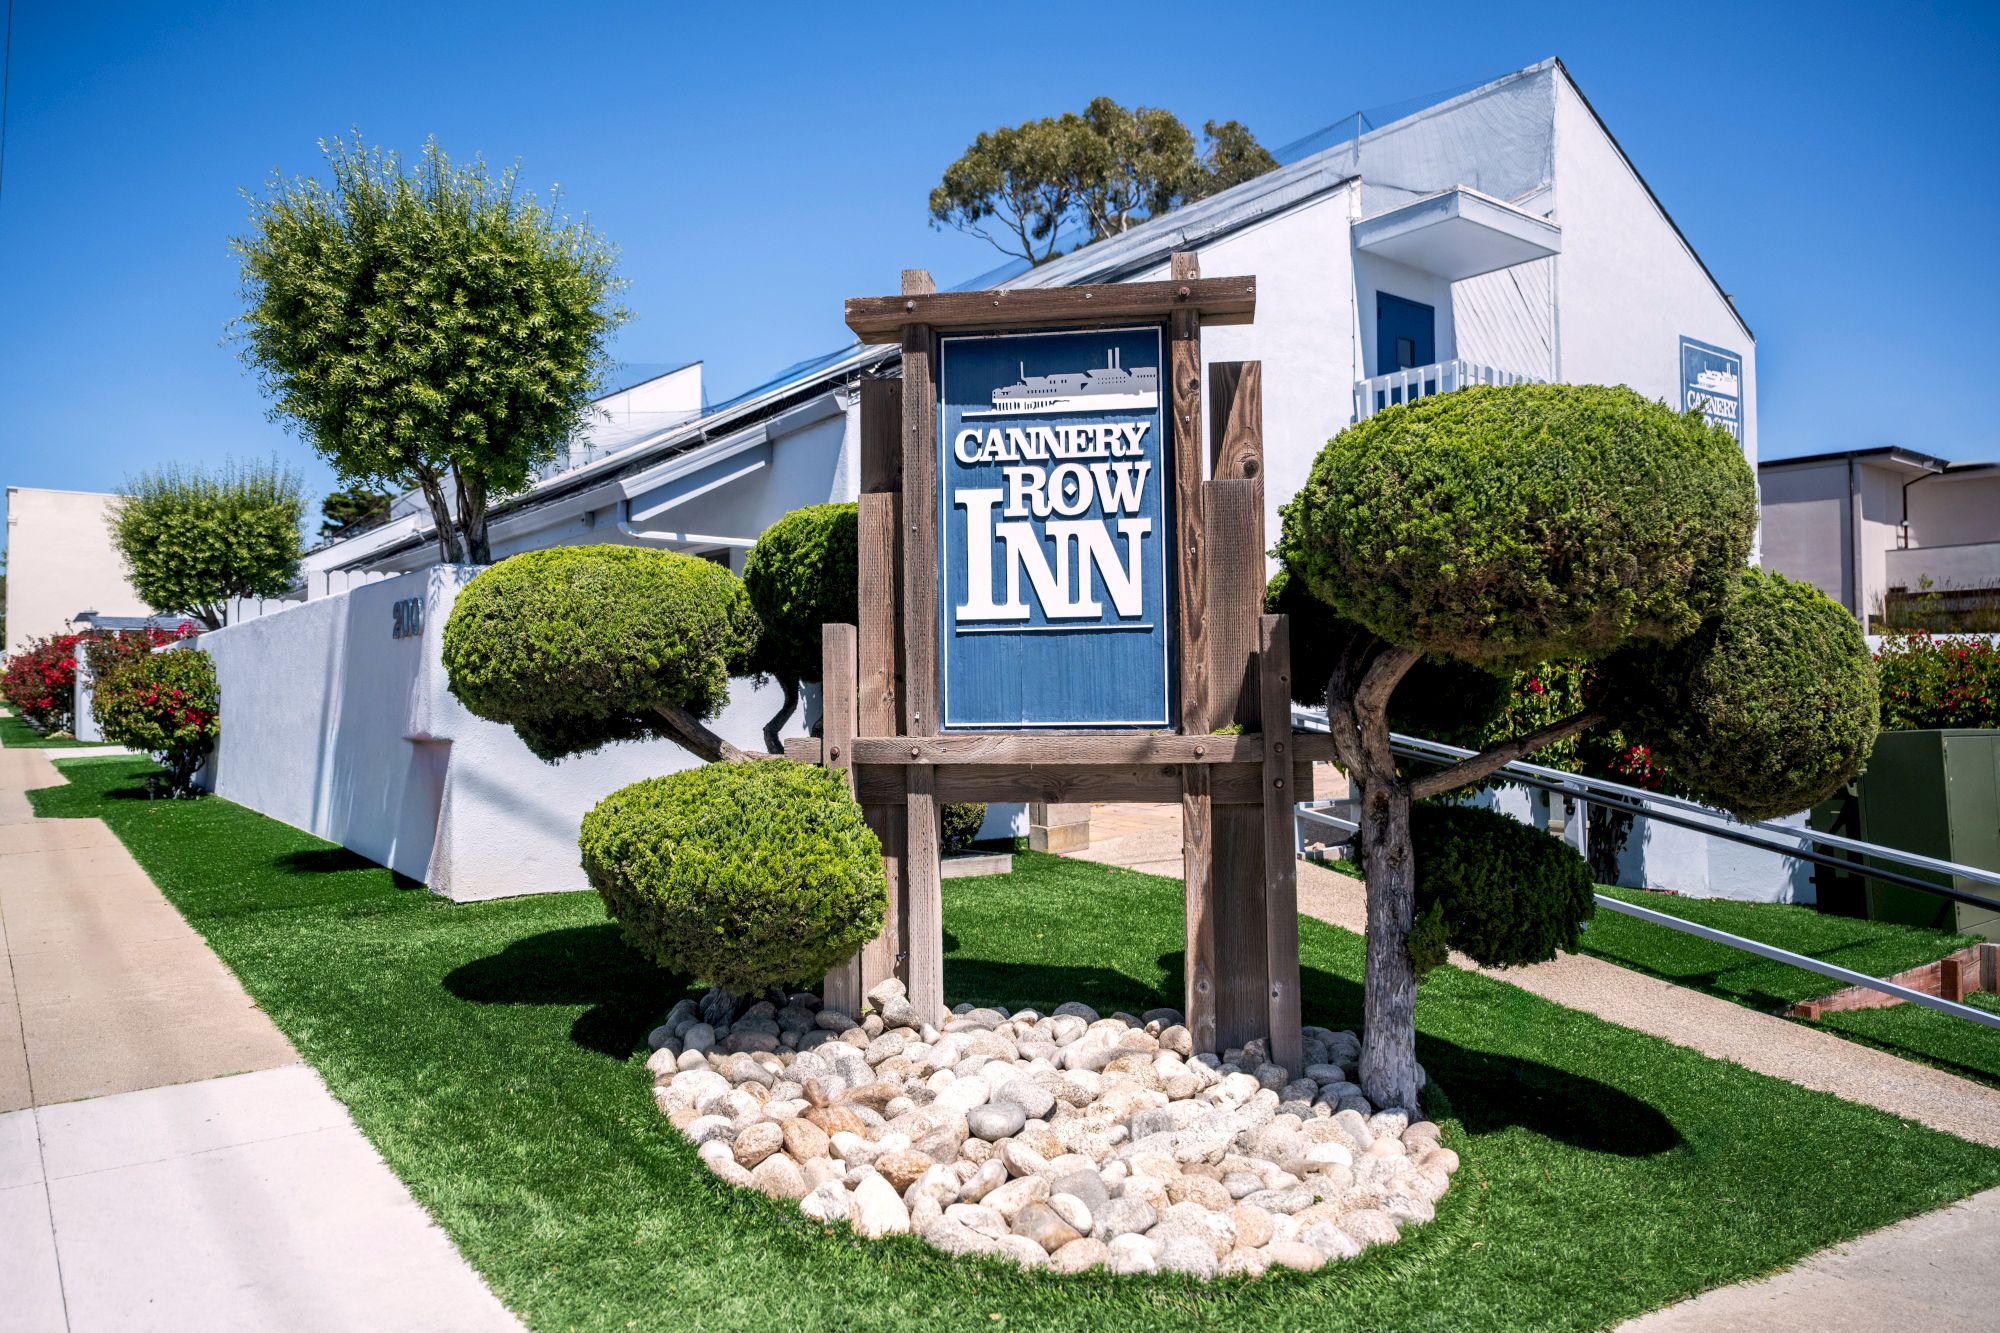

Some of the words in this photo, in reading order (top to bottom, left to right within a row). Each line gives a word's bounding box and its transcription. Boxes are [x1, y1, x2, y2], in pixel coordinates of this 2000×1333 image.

[954, 421, 1151, 464] CANNERY
[1002, 461, 1151, 518] ROW
[954, 488, 1152, 620] INN
